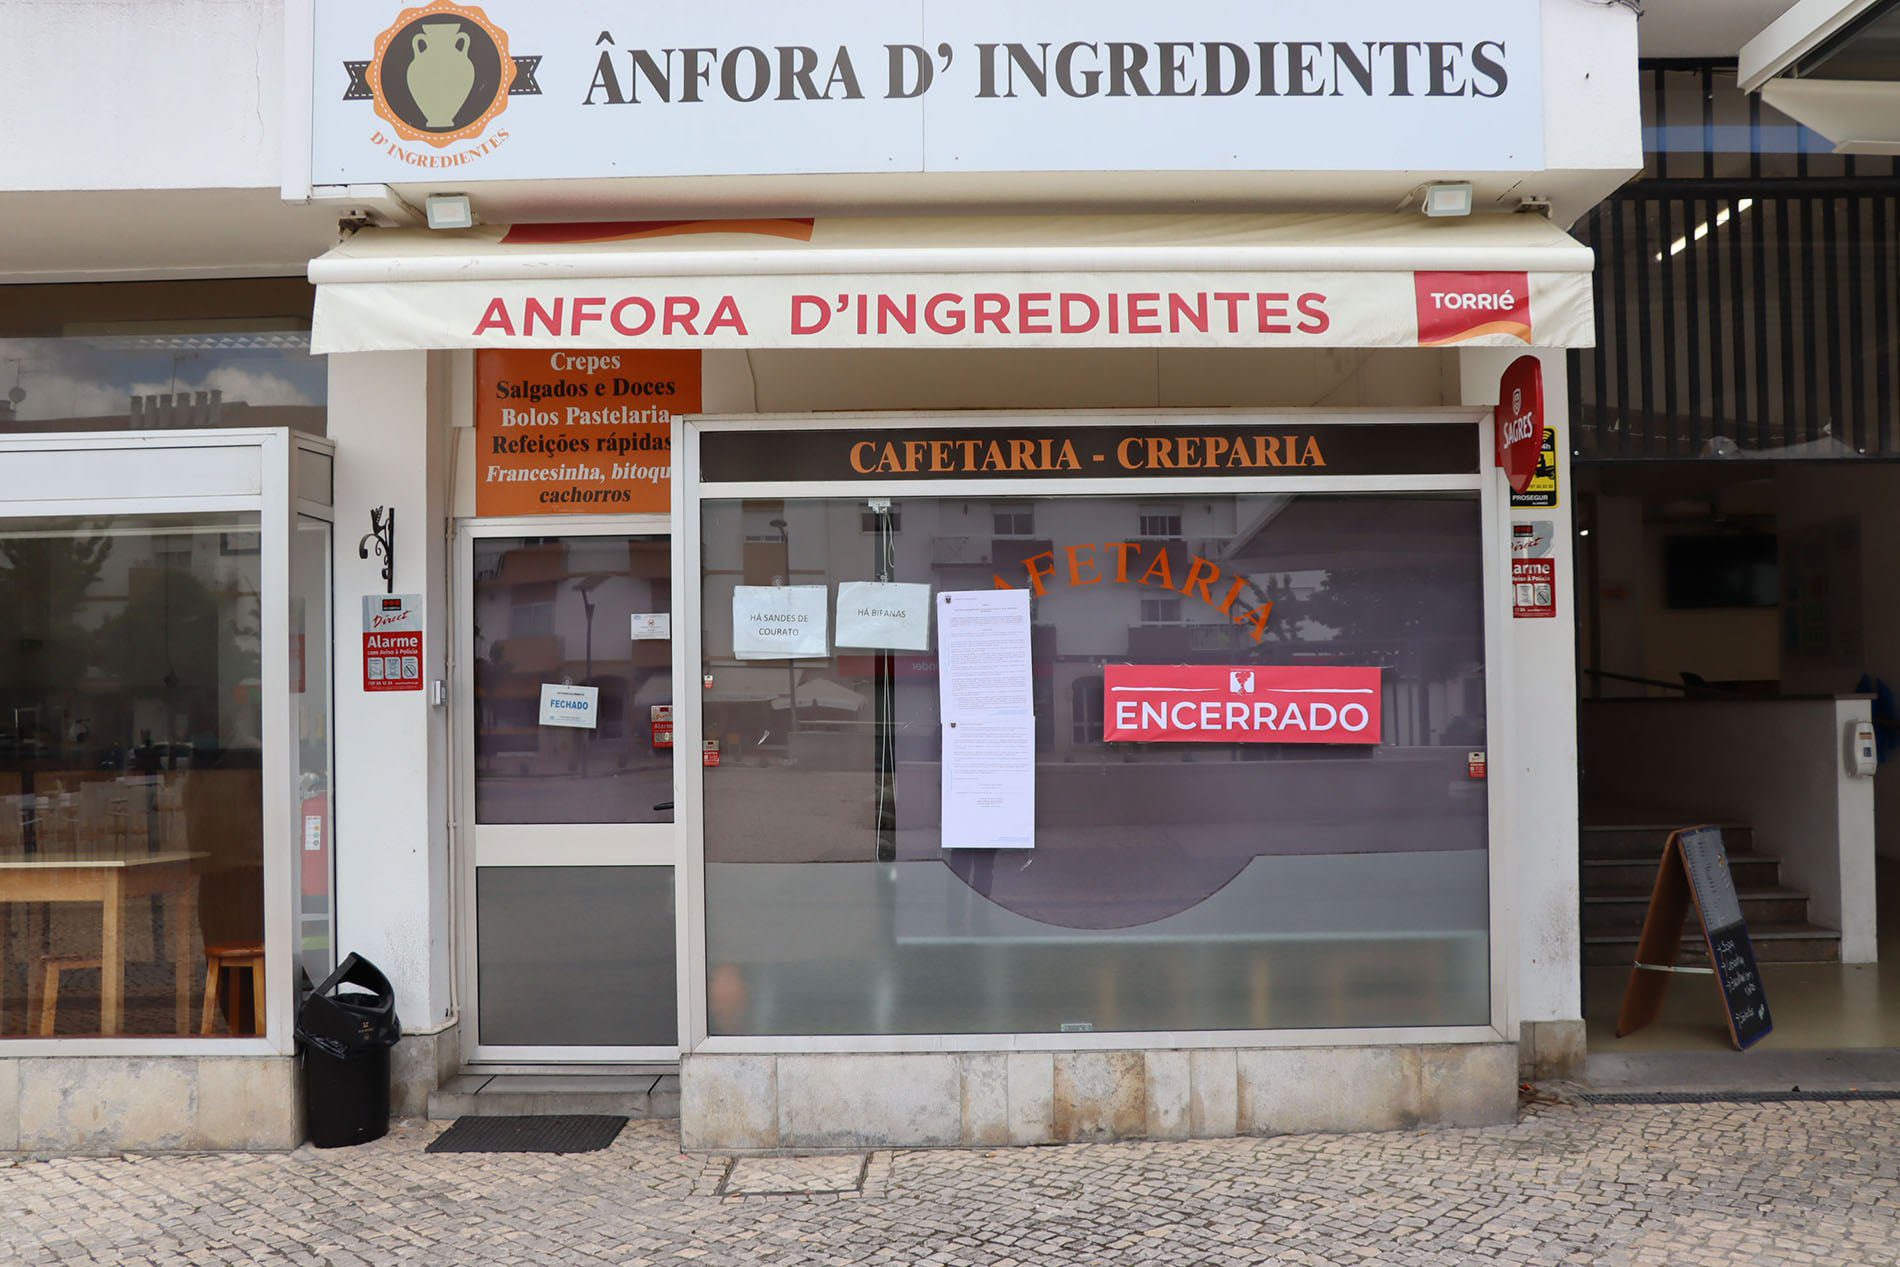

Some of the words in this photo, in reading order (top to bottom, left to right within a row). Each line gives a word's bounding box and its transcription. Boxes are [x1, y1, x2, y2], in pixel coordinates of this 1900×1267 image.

[582, 31, 864, 105] ÂNFORA
[884, 44, 953, 99] D'
[975, 40, 1509, 98] INGREDIENTES
[472, 296, 750, 337] ANFORA
[791, 292, 1331, 335] D'INGREDIENTES
[550, 352, 621, 375] Crepes
[496, 379, 588, 402] Salgados
[594, 383, 606, 397] e
[613, 377, 676, 397] Doces
[502, 408, 559, 427] Bolos
[566, 405, 670, 426] Pastelaria
[1503, 411, 1534, 449] SAGRES
[493, 434, 590, 458] Refeições
[597, 432, 671, 457] rápidas
[850, 439, 1082, 475] CAFETARIA
[1117, 434, 1326, 471] CREPARIA
[486, 464, 606, 483] Francesinha,
[612, 462, 671, 484] bitoqu
[540, 486, 632, 504] cachorros
[1511, 537, 1543, 551] irect
[1512, 563, 1551, 575] arme
[750, 611, 762, 622] HÁ
[763, 614, 796, 623] SANDES
[797, 614, 808, 623] DE
[857, 606, 870, 617] HÁ
[871, 609, 906, 618] BIFANAS
[368, 635, 418, 648] Alarme
[758, 627, 799, 636] COURATO
[550, 698, 590, 711] FECHADO
[1116, 701, 1370, 732] ENCERRADO
